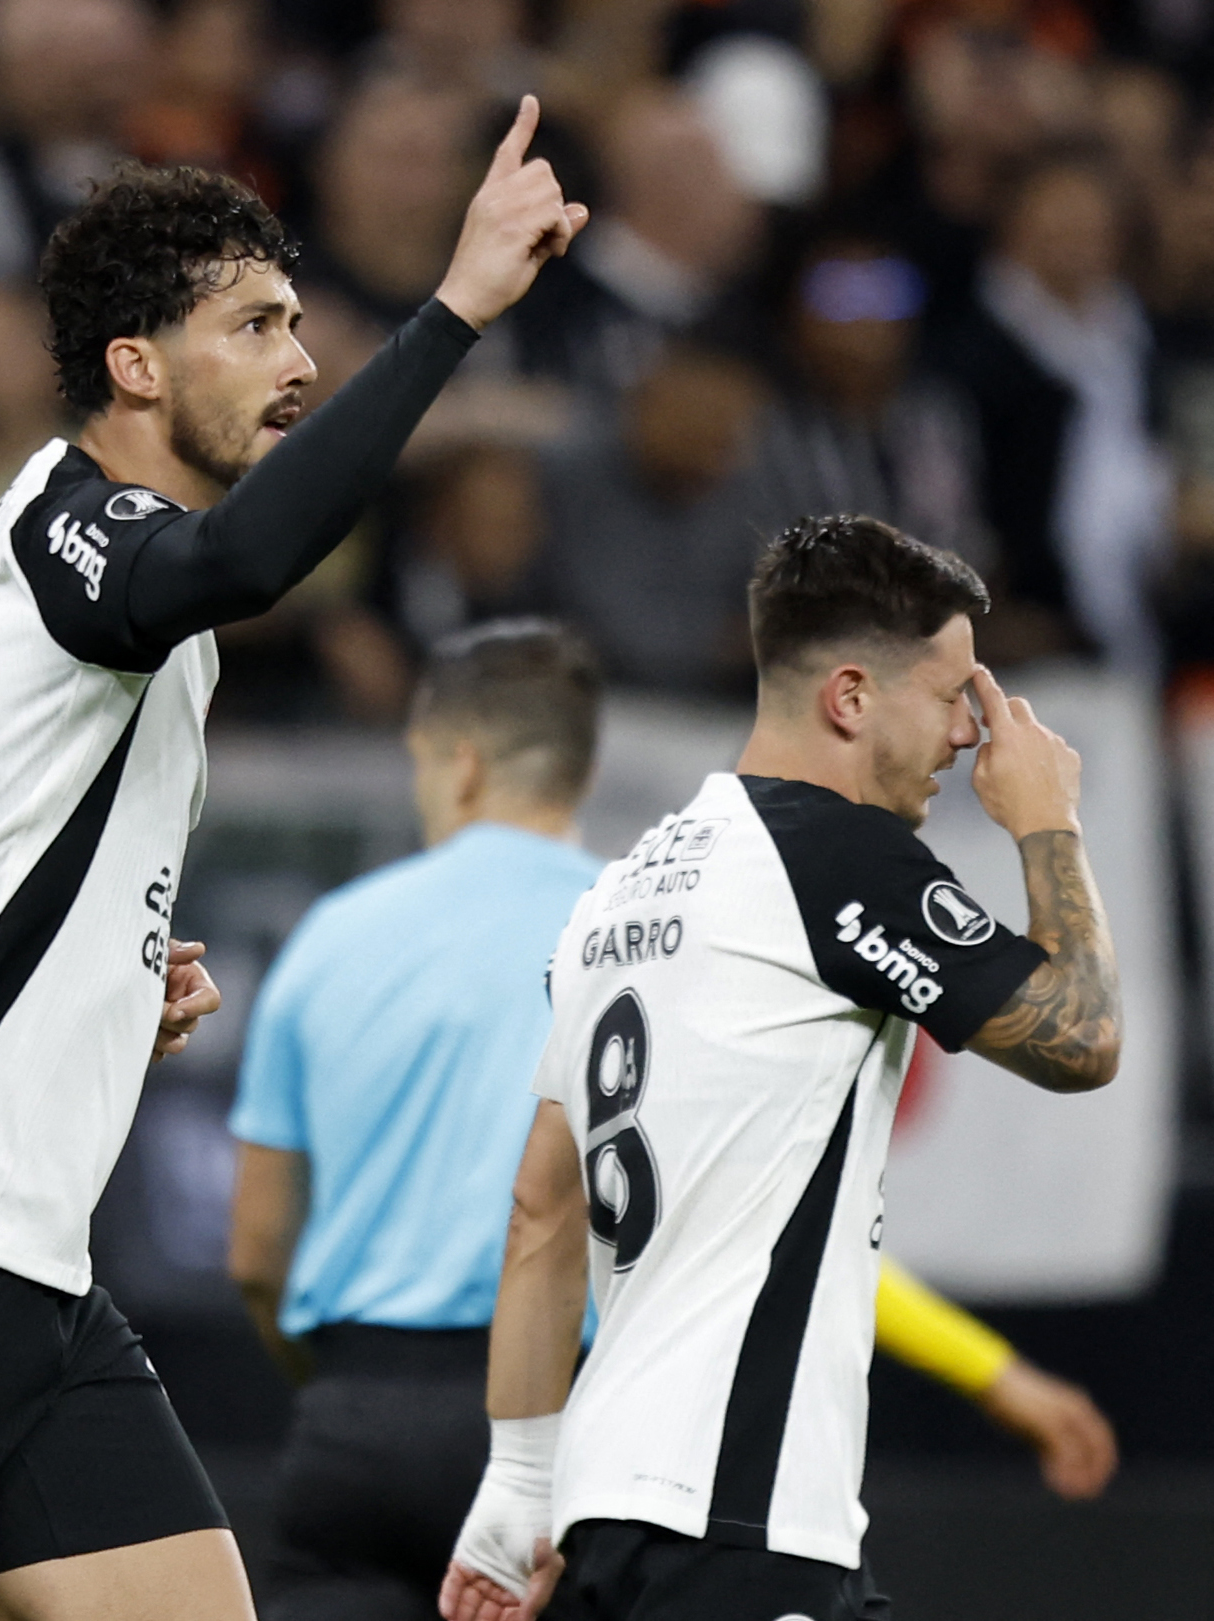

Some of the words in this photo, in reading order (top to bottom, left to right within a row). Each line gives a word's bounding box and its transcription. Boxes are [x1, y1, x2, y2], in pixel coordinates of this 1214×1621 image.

[60, 520, 108, 602] bmg
[653, 869, 701, 898] AUTO
[582, 914, 683, 970] GARRO
[853, 924, 944, 1015] bmg
[898, 939, 940, 973] banco
[585, 986, 662, 1274] 8
